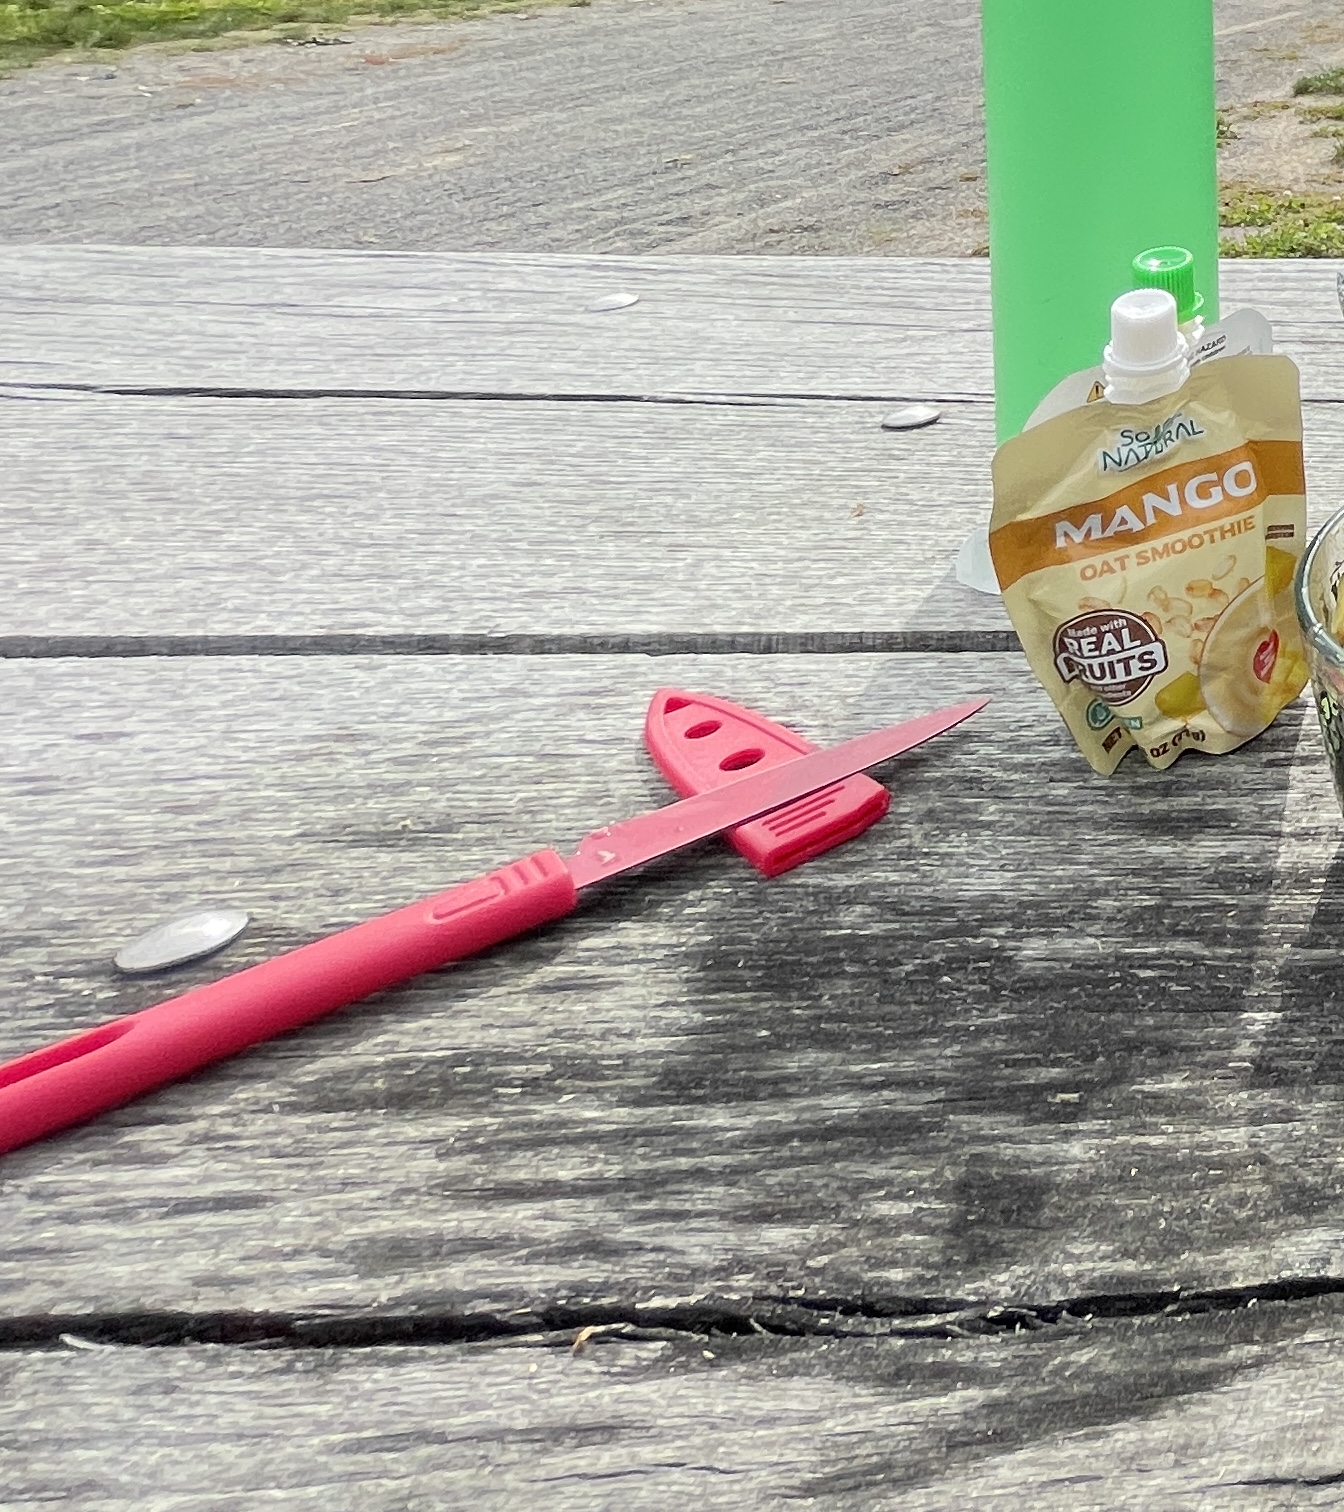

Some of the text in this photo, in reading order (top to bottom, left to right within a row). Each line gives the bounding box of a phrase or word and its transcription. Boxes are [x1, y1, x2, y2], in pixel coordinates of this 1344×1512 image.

[1102, 419, 1205, 471] NATURAL
[1055, 460, 1258, 549] MANGO
[1079, 514, 1256, 581] OAT SMOOTHIE
[1063, 627, 1141, 657] REAL
[1100, 618, 1127, 632] with
